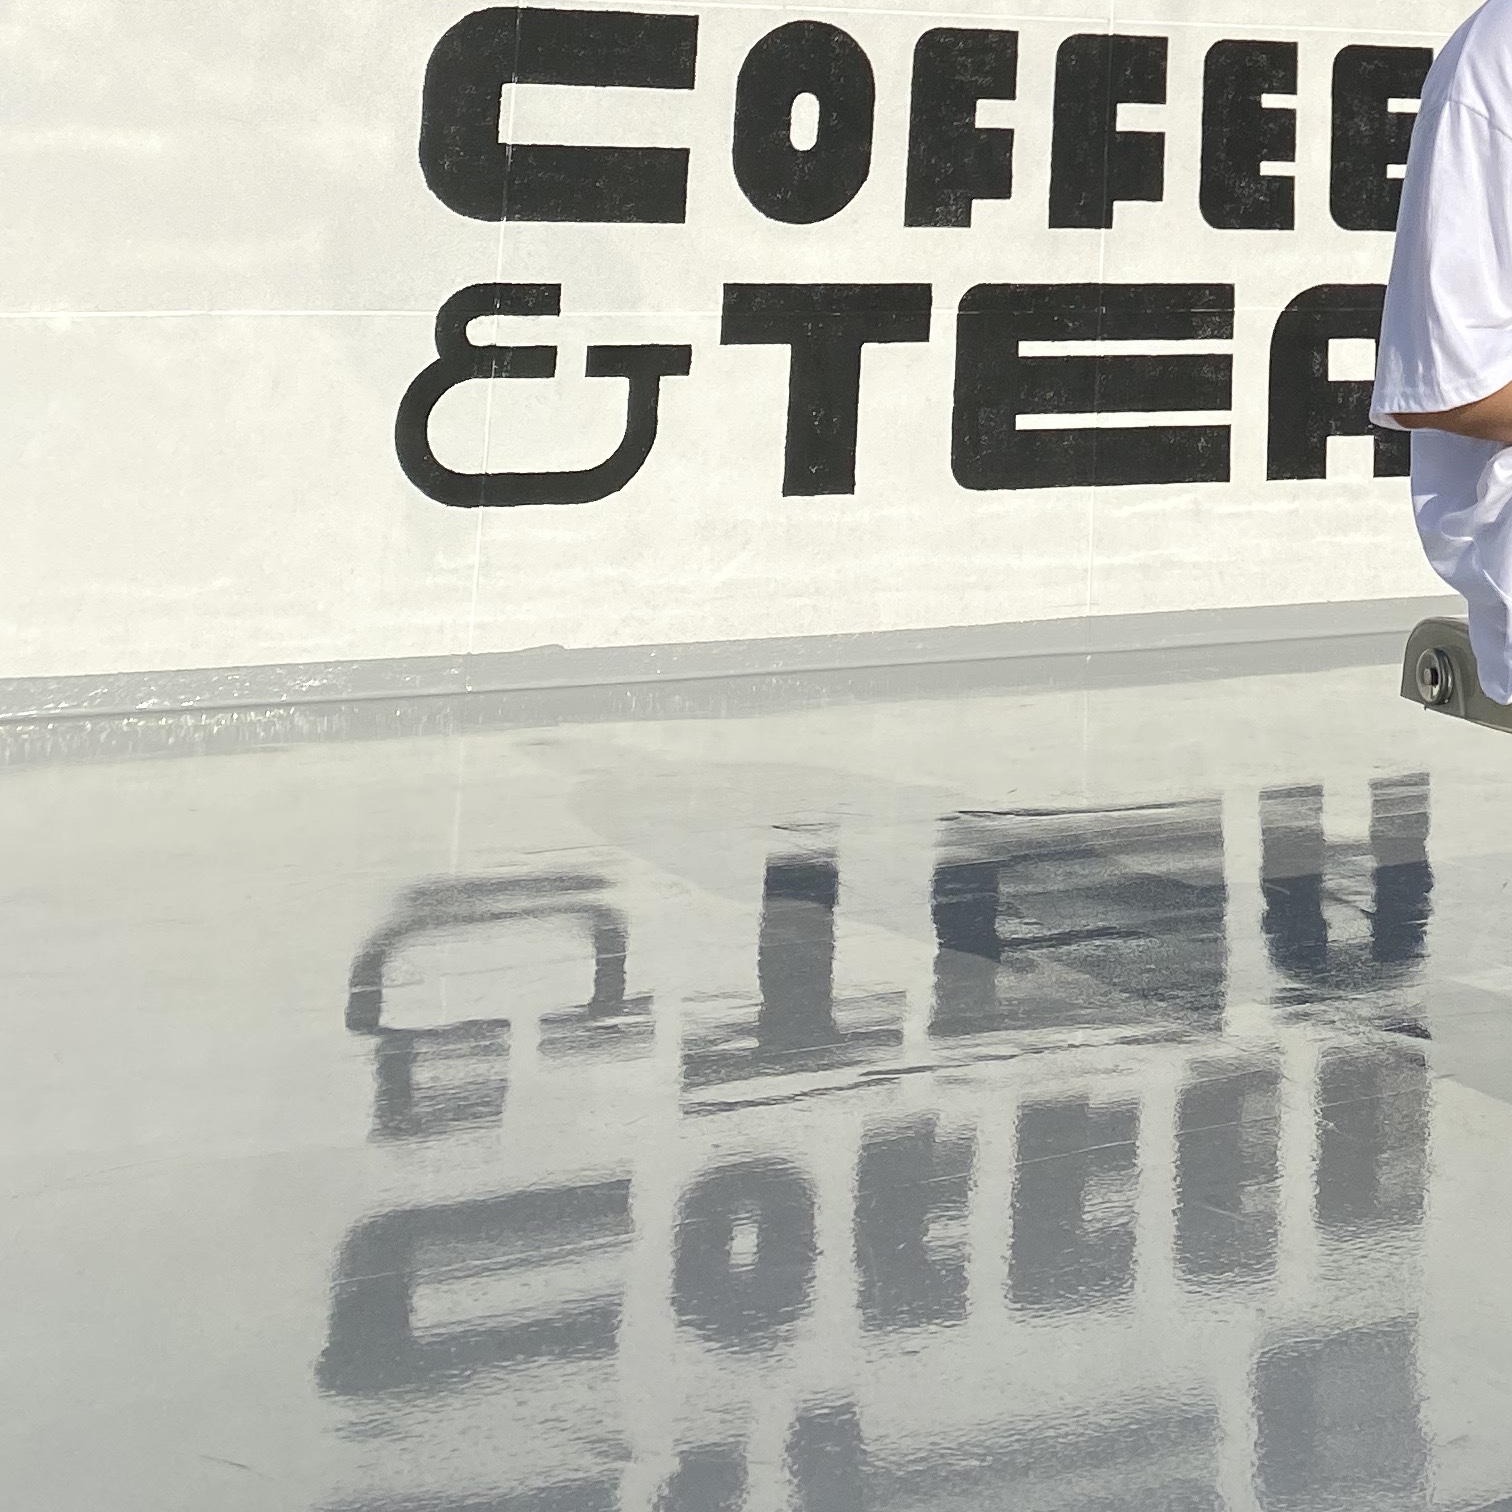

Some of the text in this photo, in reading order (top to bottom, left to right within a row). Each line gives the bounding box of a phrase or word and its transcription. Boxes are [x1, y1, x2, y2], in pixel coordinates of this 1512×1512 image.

[418, 6, 1435, 231] COFFEE
[395, 282, 1411, 508] & TEA
